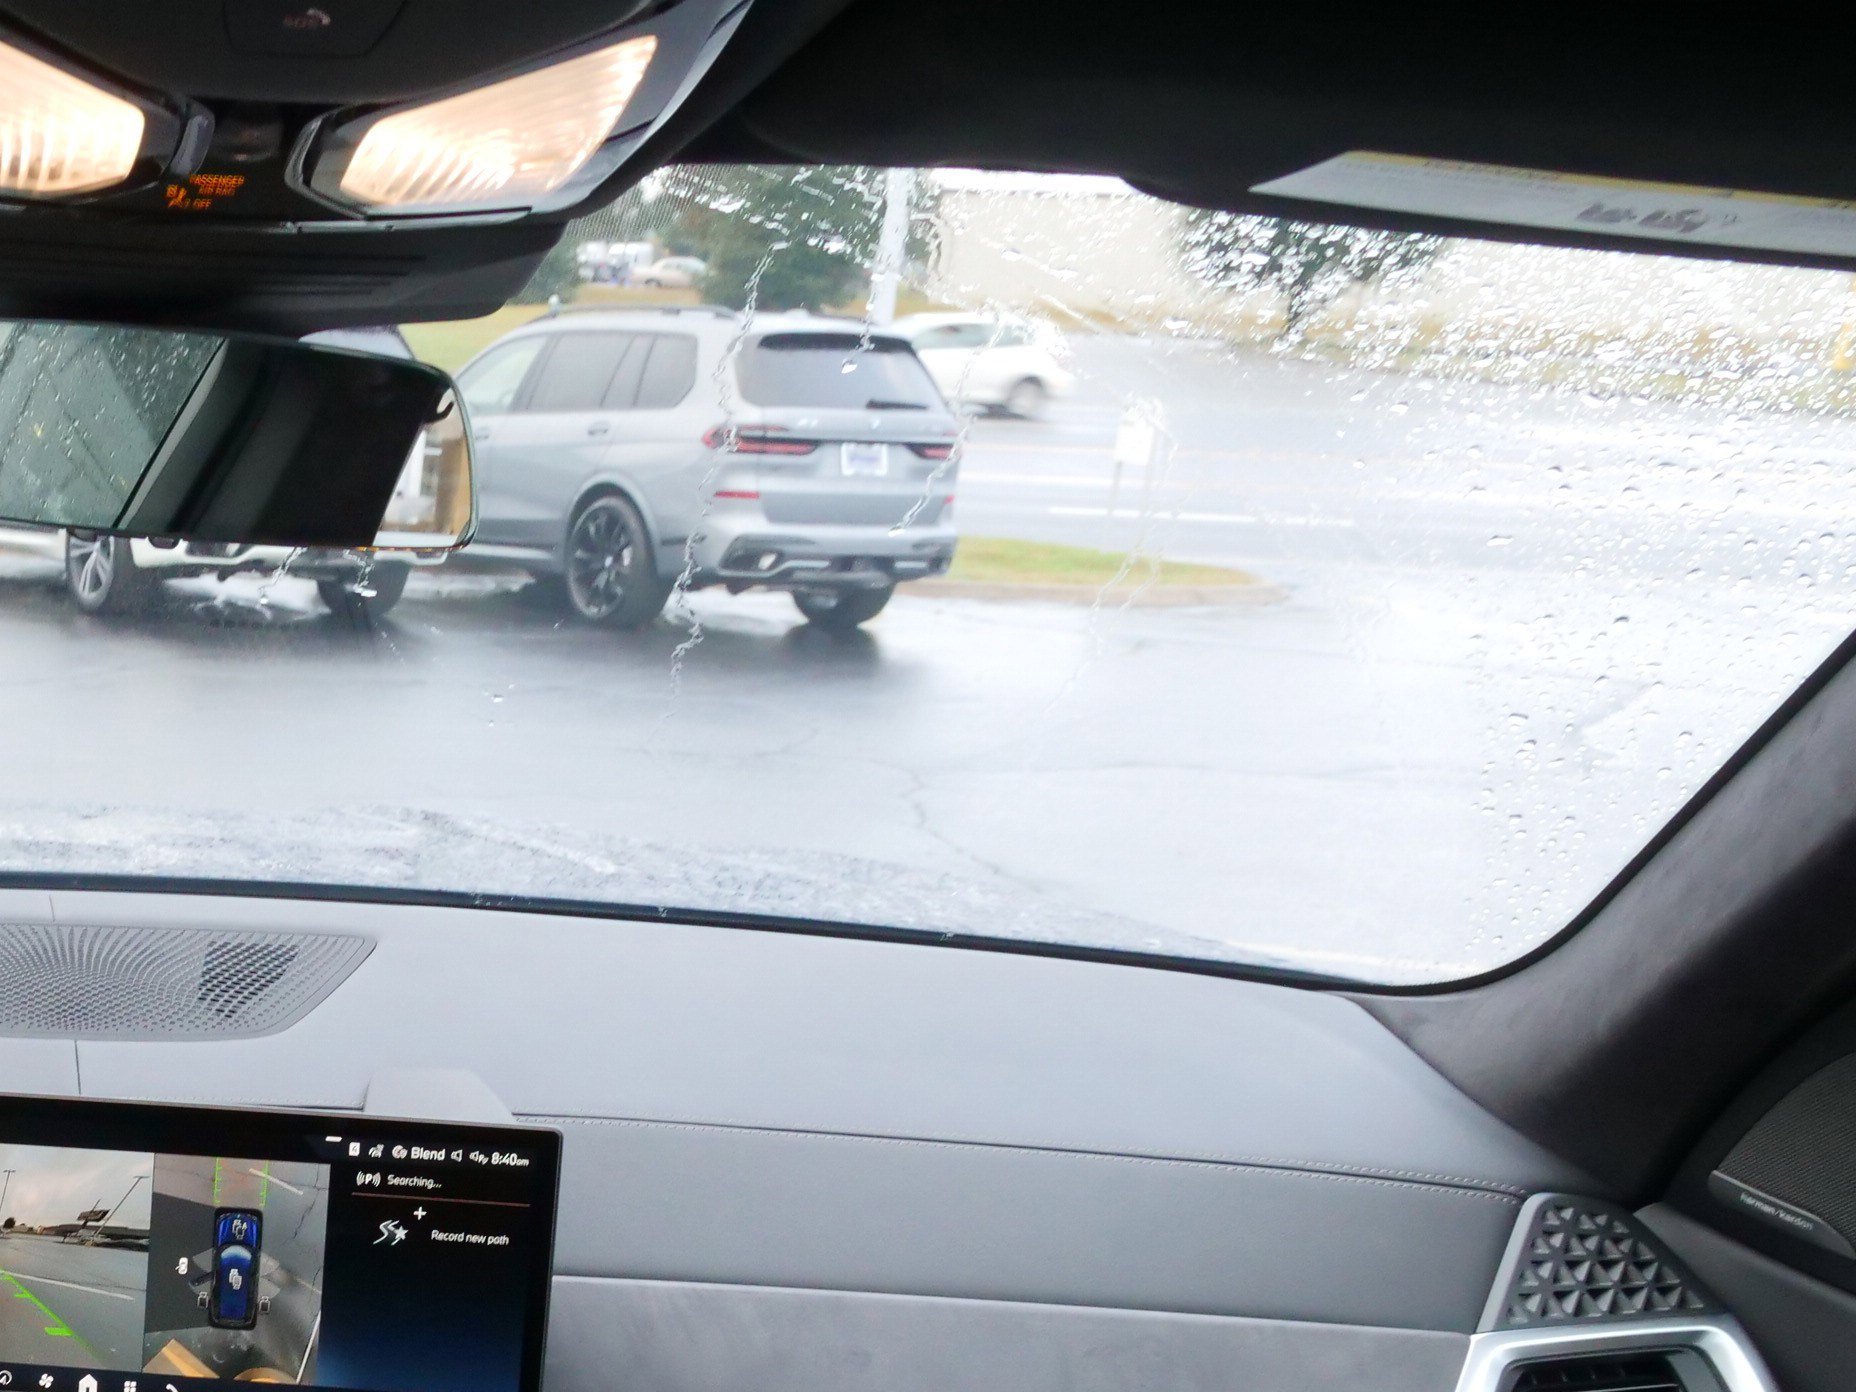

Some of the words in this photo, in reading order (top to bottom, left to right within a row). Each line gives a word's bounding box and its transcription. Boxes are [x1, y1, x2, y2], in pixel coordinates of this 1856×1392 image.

[189, 174, 245, 186] PASSENGER
[193, 199, 213, 209] OFF
[410, 1147, 446, 1161] Blend
[431, 1229, 464, 1242] Record
[465, 1235, 486, 1243] new
[487, 1235, 510, 1246] path
